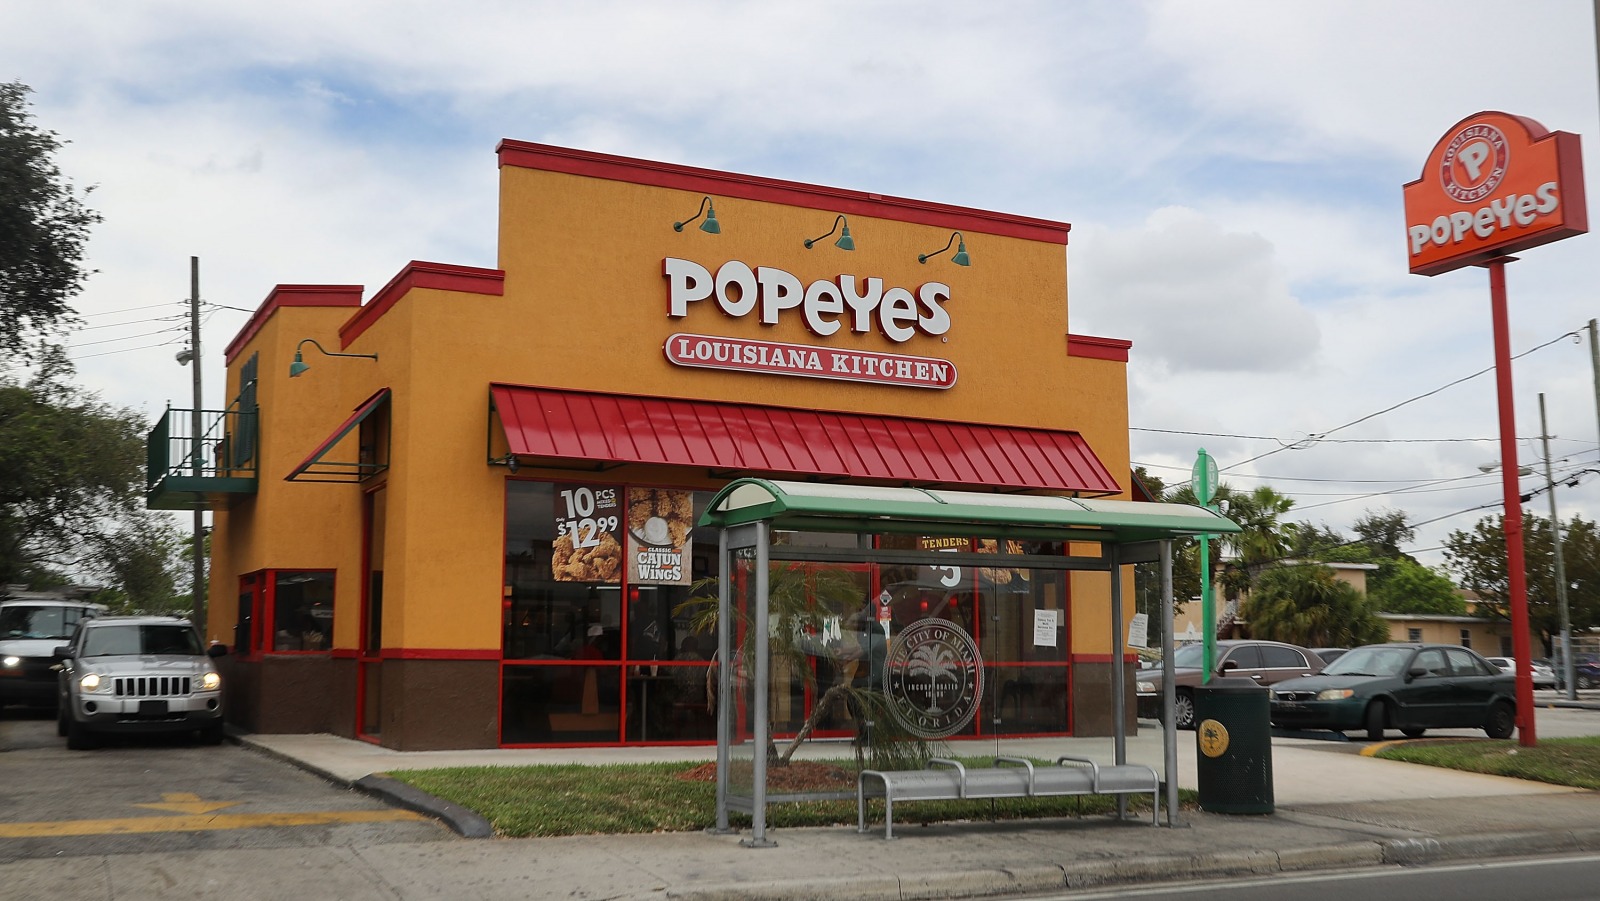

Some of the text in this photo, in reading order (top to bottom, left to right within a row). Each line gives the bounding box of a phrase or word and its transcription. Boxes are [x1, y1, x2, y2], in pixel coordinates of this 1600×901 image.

[1444, 126, 1504, 167] LOUISIANA
[1457, 141, 1489, 182] P
[1446, 168, 1504, 200] KITCHEN
[678, 339, 948, 382] LOUISIANA KITCHEN
[561, 487, 616, 518] 10 PCS
[922, 538, 969, 548] TENDERS
[637, 552, 681, 568] CAJUN
[893, 629, 975, 675] THE CITY OF MIAMI
[898, 696, 971, 727] FLORIDA
